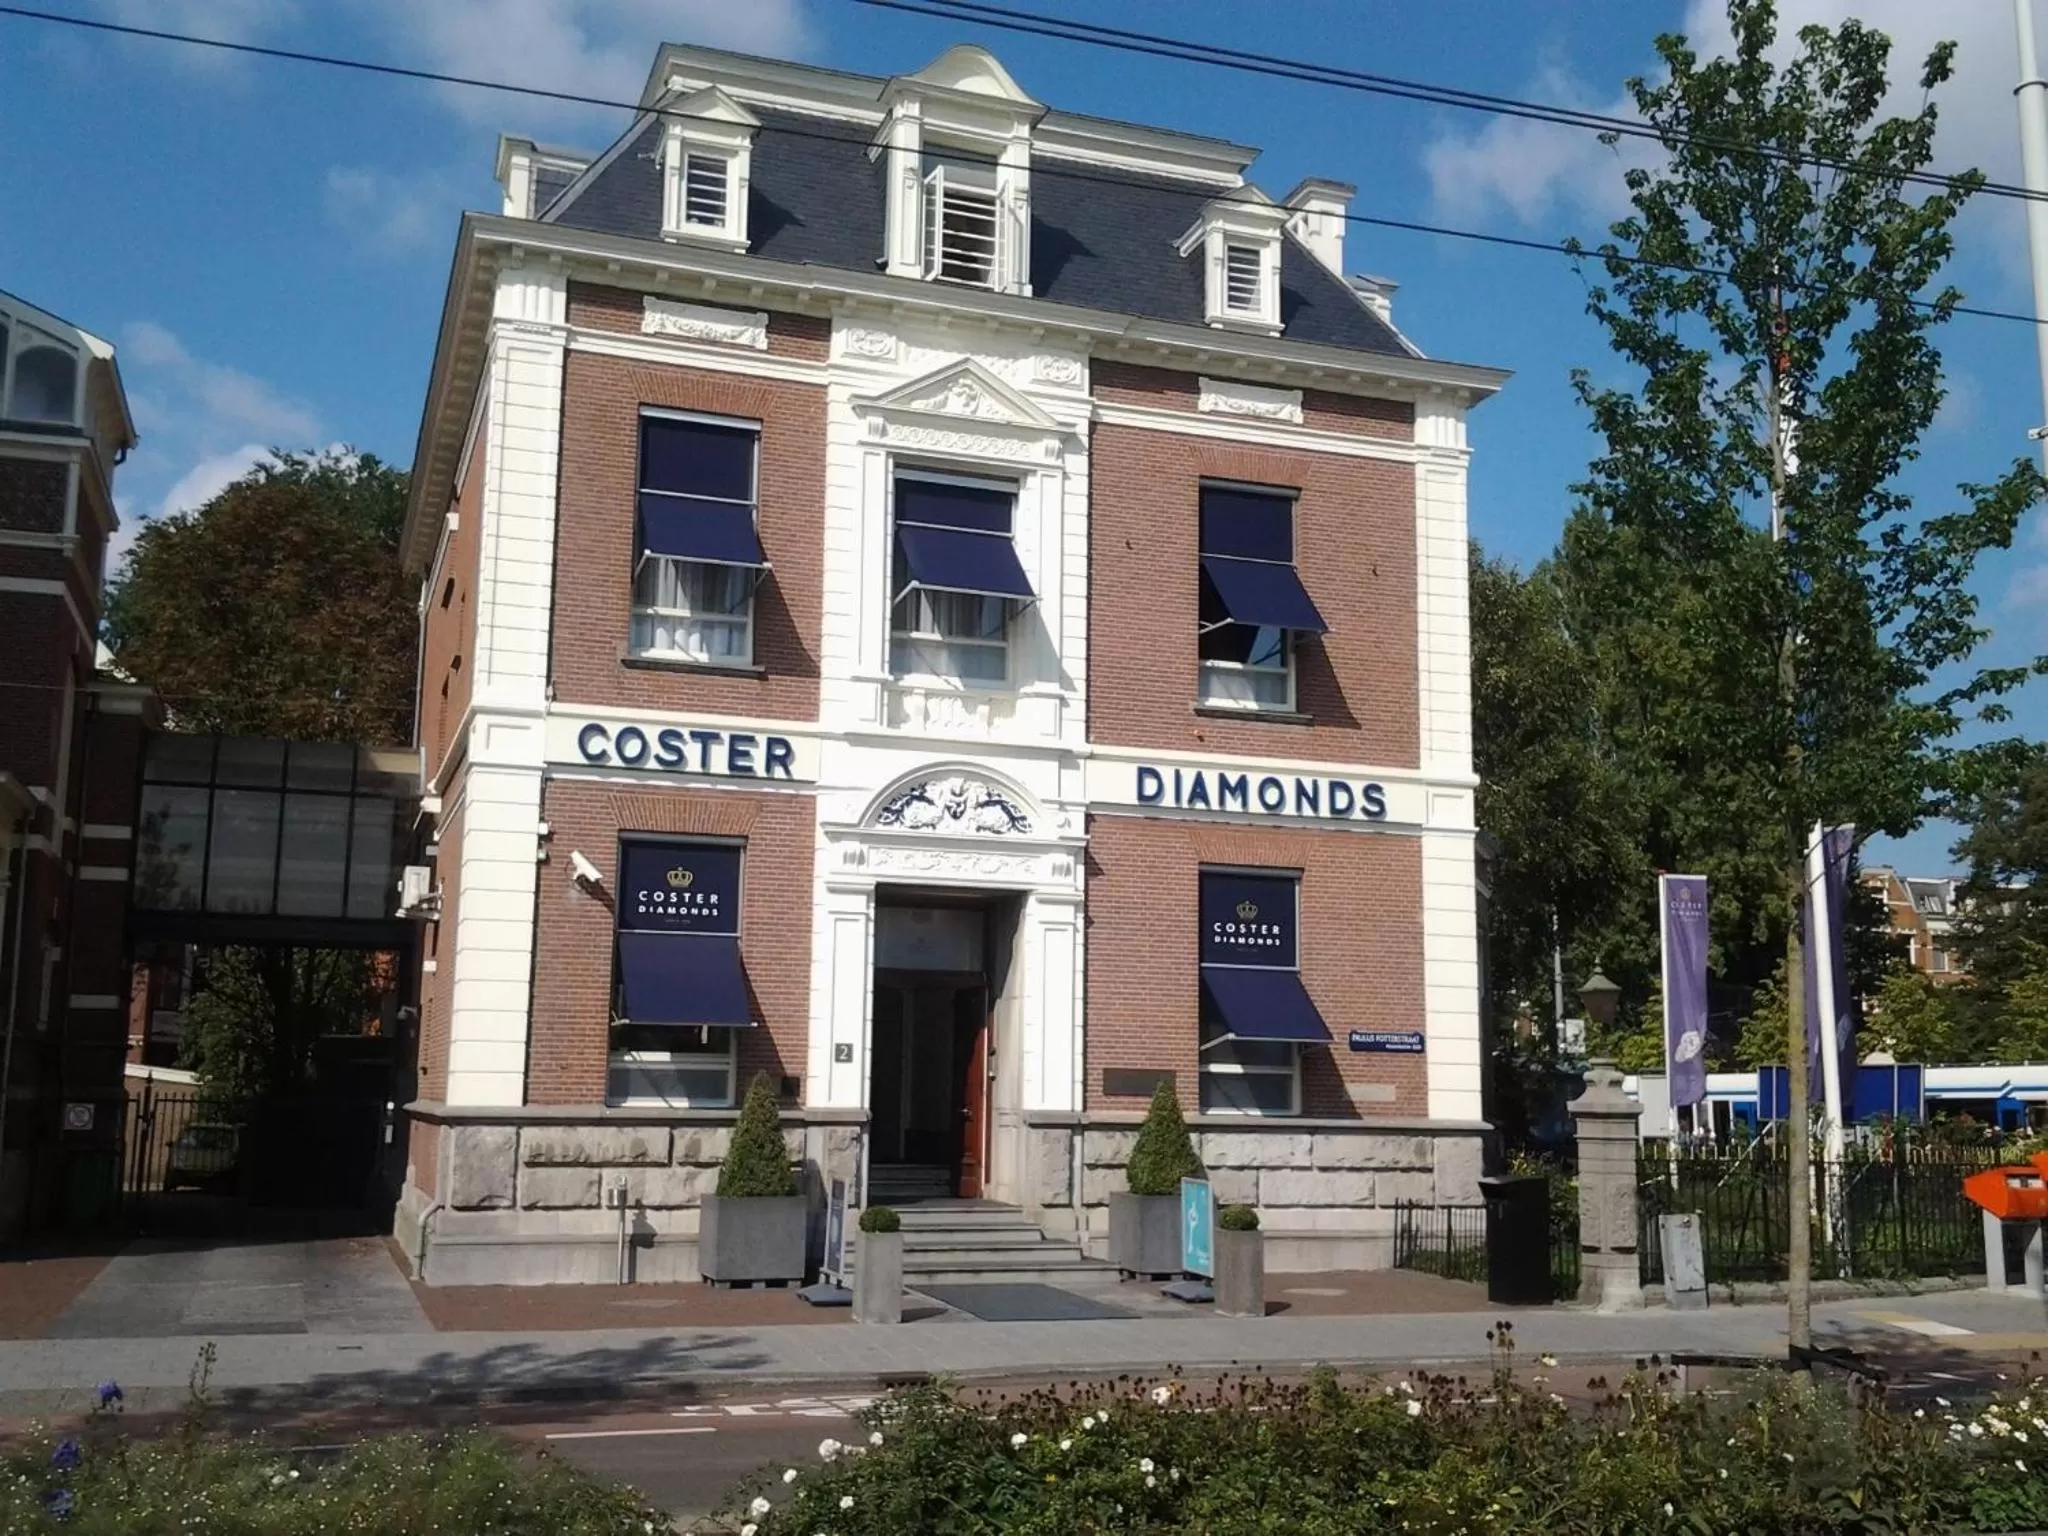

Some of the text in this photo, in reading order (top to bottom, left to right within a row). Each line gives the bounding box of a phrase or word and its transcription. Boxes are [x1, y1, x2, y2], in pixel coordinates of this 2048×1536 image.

[578, 723, 794, 779] COSTER
[1137, 766, 1387, 819] DIAMONDS
[638, 890, 719, 904] COSTER
[638, 905, 719, 916] DIAMONDS
[1213, 922, 1280, 935] COSTER
[1214, 935, 1281, 946] DIAMONDS
[839, 1045, 849, 1060] 2
